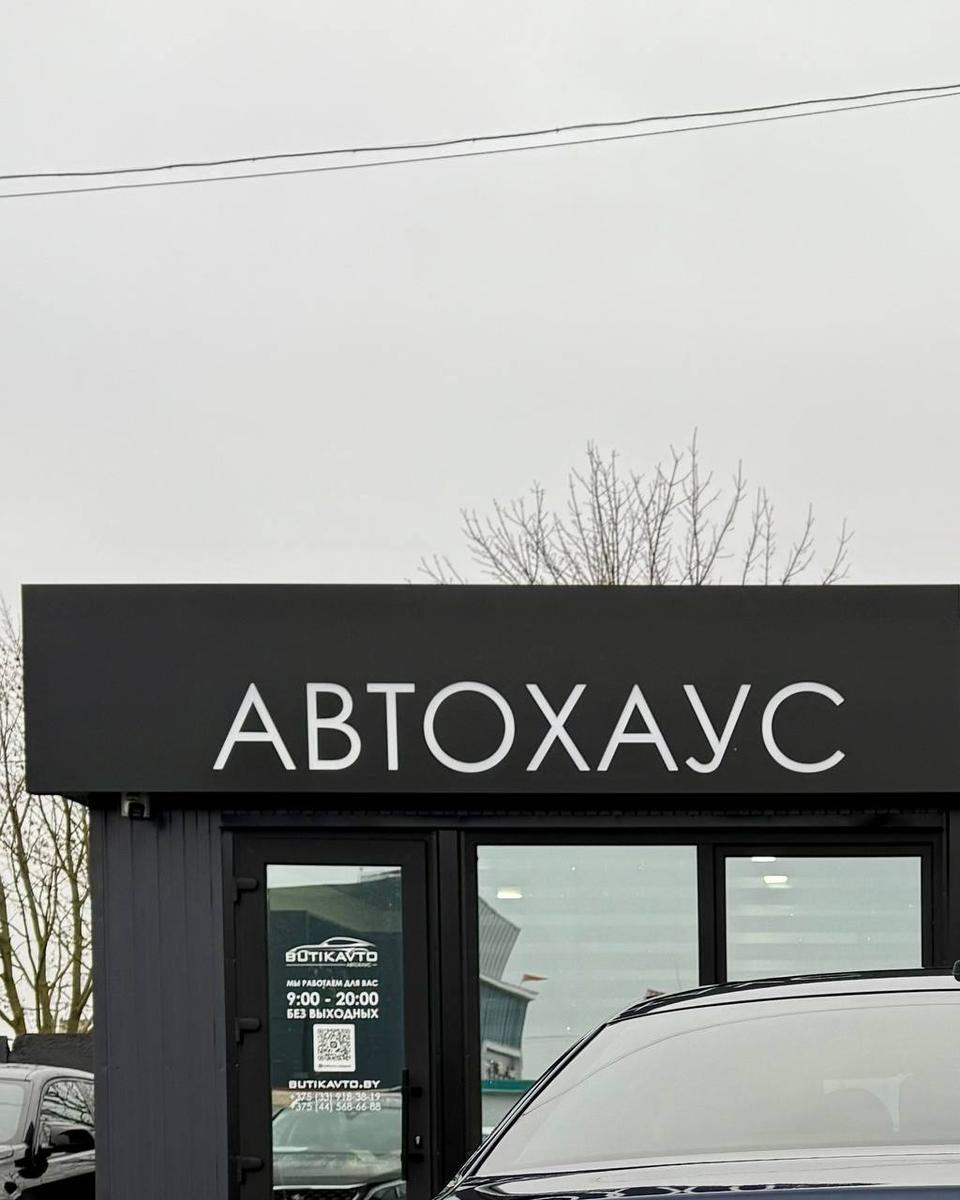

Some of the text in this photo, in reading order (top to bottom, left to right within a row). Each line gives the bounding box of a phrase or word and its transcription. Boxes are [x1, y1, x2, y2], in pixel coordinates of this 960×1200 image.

[213, 681, 846, 774] АВТОХАУС
[285, 951, 378, 962] BUTIKAVTO
[286, 979, 301, 987] МЫ
[286, 992, 320, 1006] 9:00
[336, 992, 379, 1006] 20:00
[286, 1008, 379, 1020] БЕЗ ВЫХОДНЫХ
[288, 1080, 381, 1089] BUTIKAVTO.BY
[335, 1101, 381, 1111] 568-66-88
